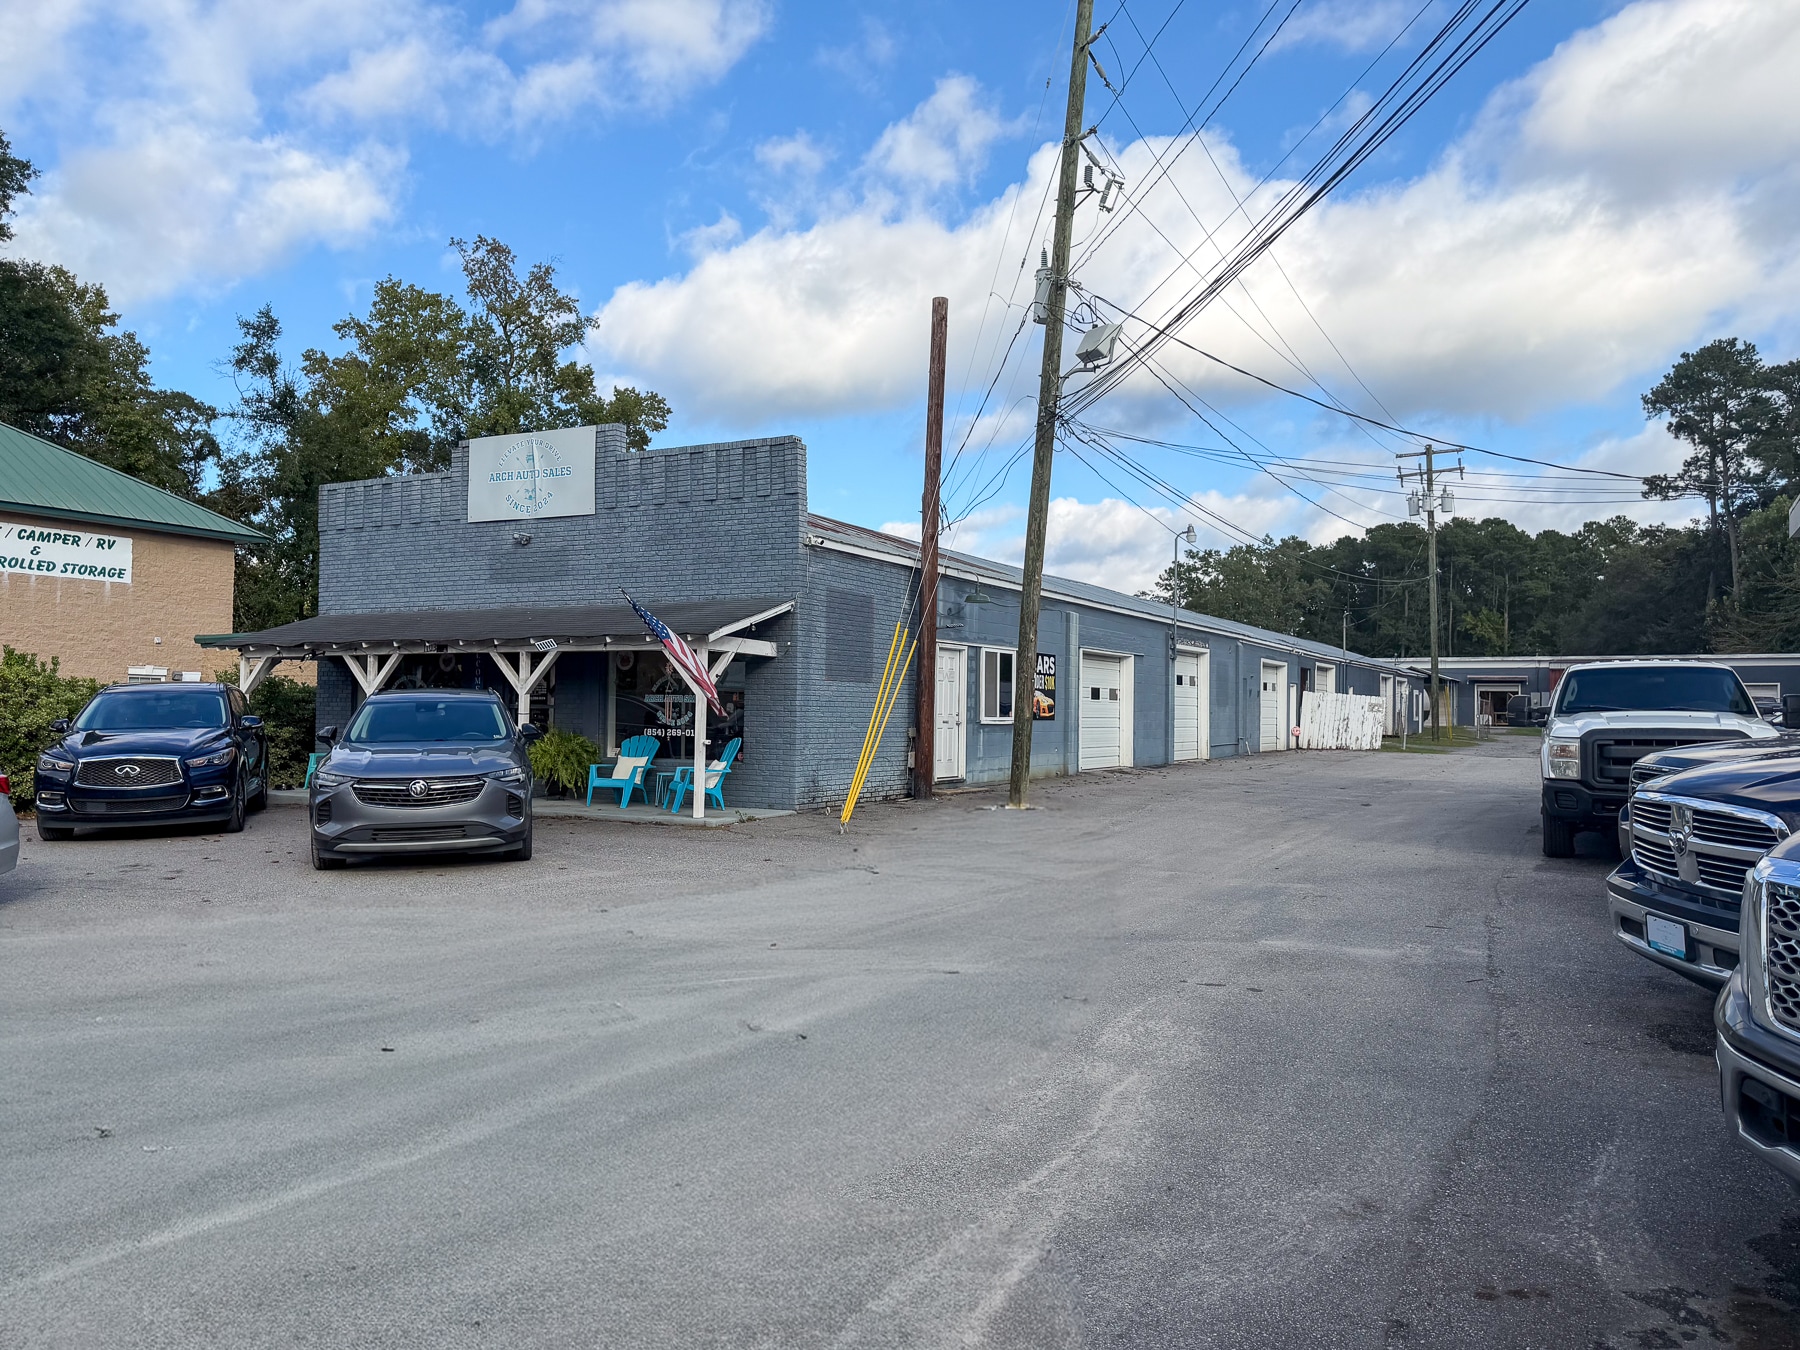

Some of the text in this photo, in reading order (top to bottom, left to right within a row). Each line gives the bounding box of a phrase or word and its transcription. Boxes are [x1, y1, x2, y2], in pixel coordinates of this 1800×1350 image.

[526, 438, 544, 447] YOUR
[544, 441, 562, 462] DRIVE
[489, 466, 572, 482] ARCH AUTO SALES
[505, 491, 554, 514] SINCE 2024
[17, 528, 82, 547] CAMPER
[96, 538, 117, 550] RV
[30, 545, 41, 556] &
[60, 562, 127, 579] STORAGE
[1037, 655, 1055, 675] ARS
[643, 728, 665, 738] (854)
